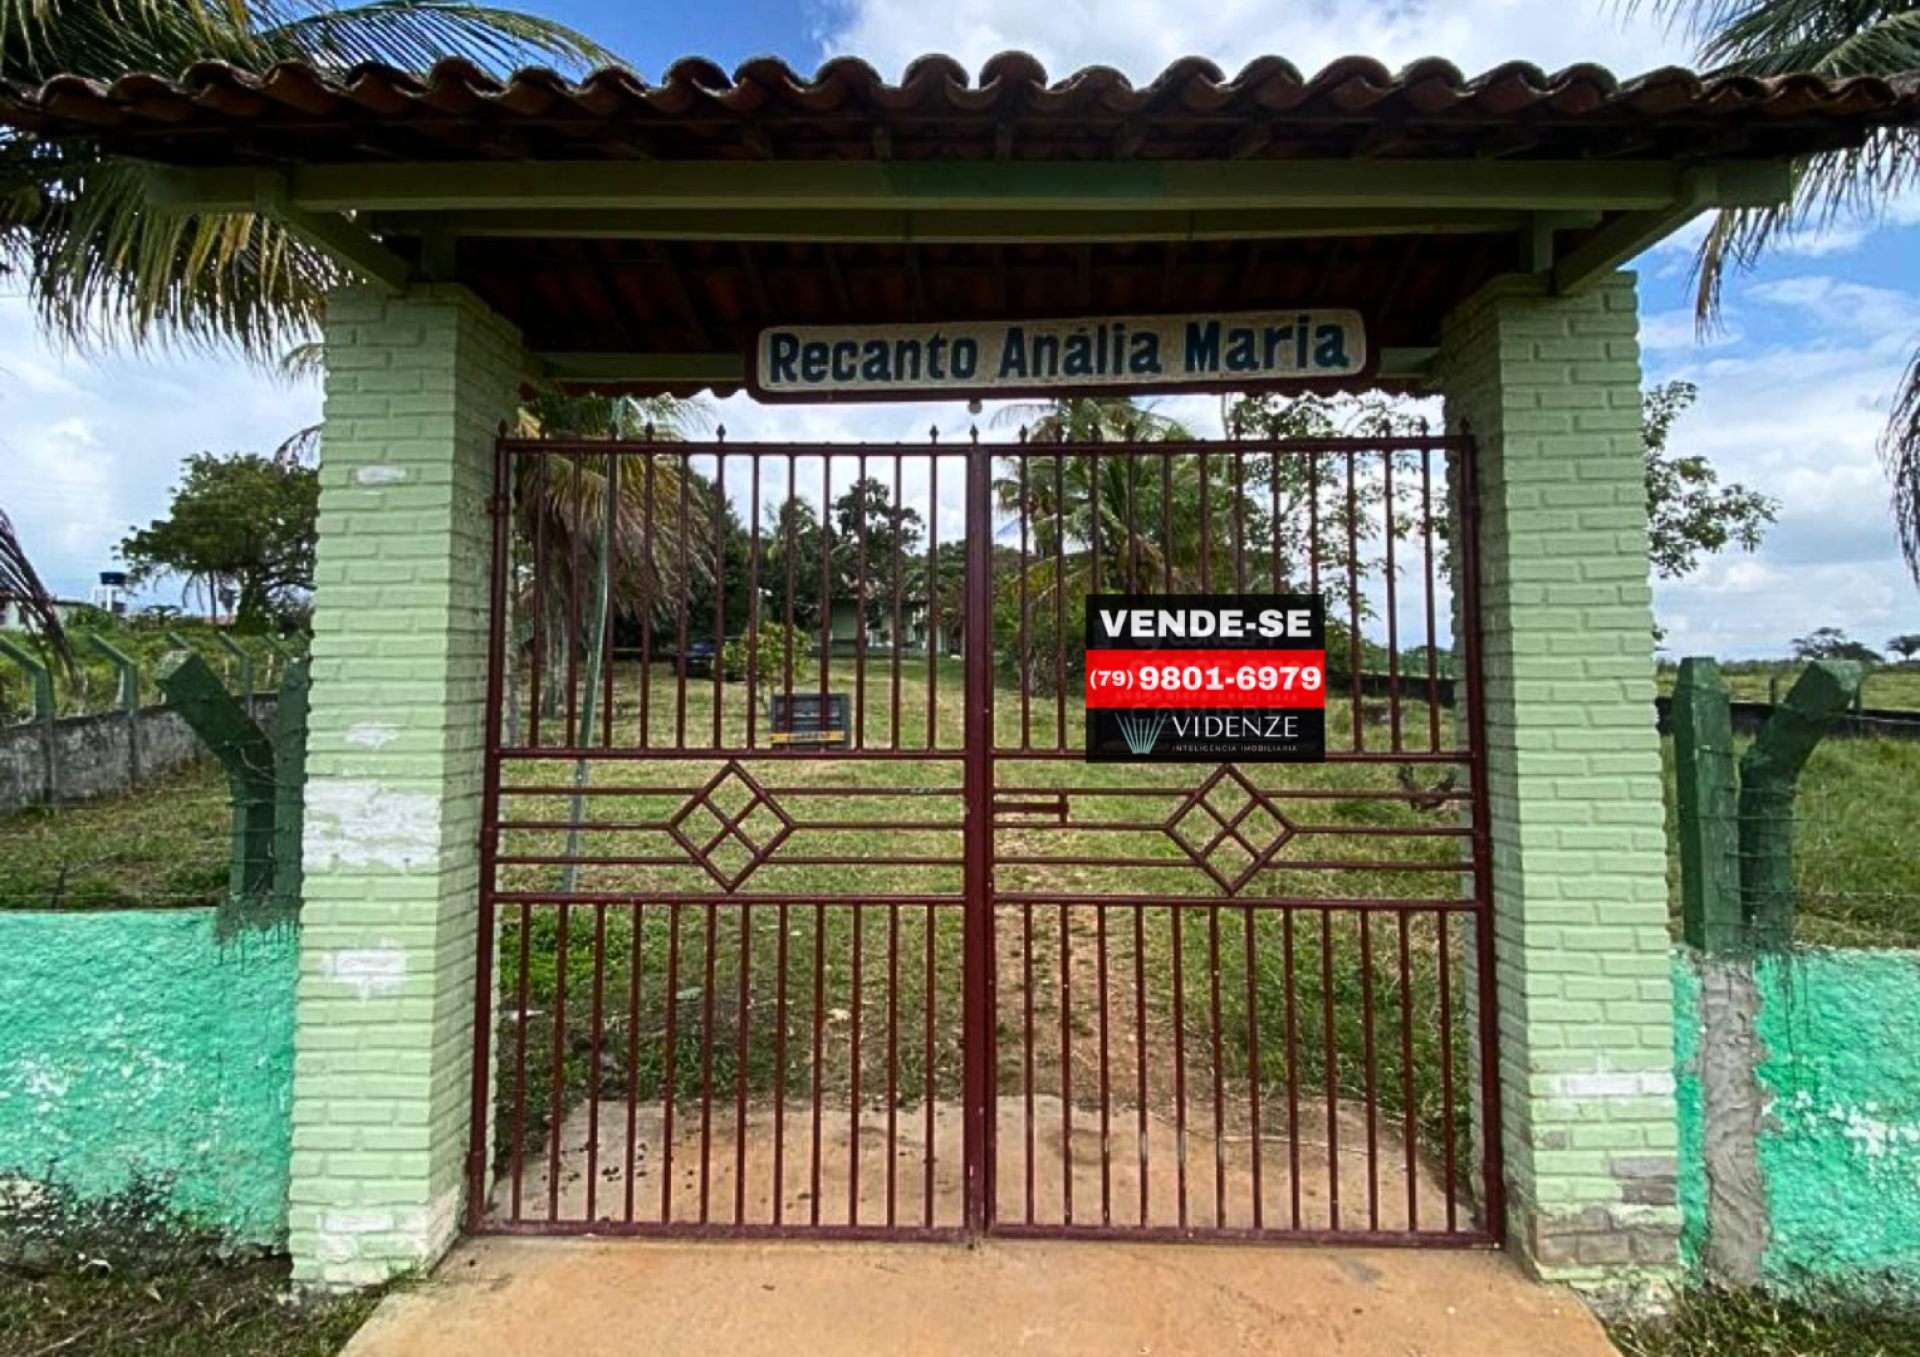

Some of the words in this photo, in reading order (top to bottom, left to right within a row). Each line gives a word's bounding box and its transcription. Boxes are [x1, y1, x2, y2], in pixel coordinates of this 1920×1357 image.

[770, 330, 978, 383] Recanto
[999, 322, 1162, 377] Anália
[1185, 315, 1349, 372] Maria
